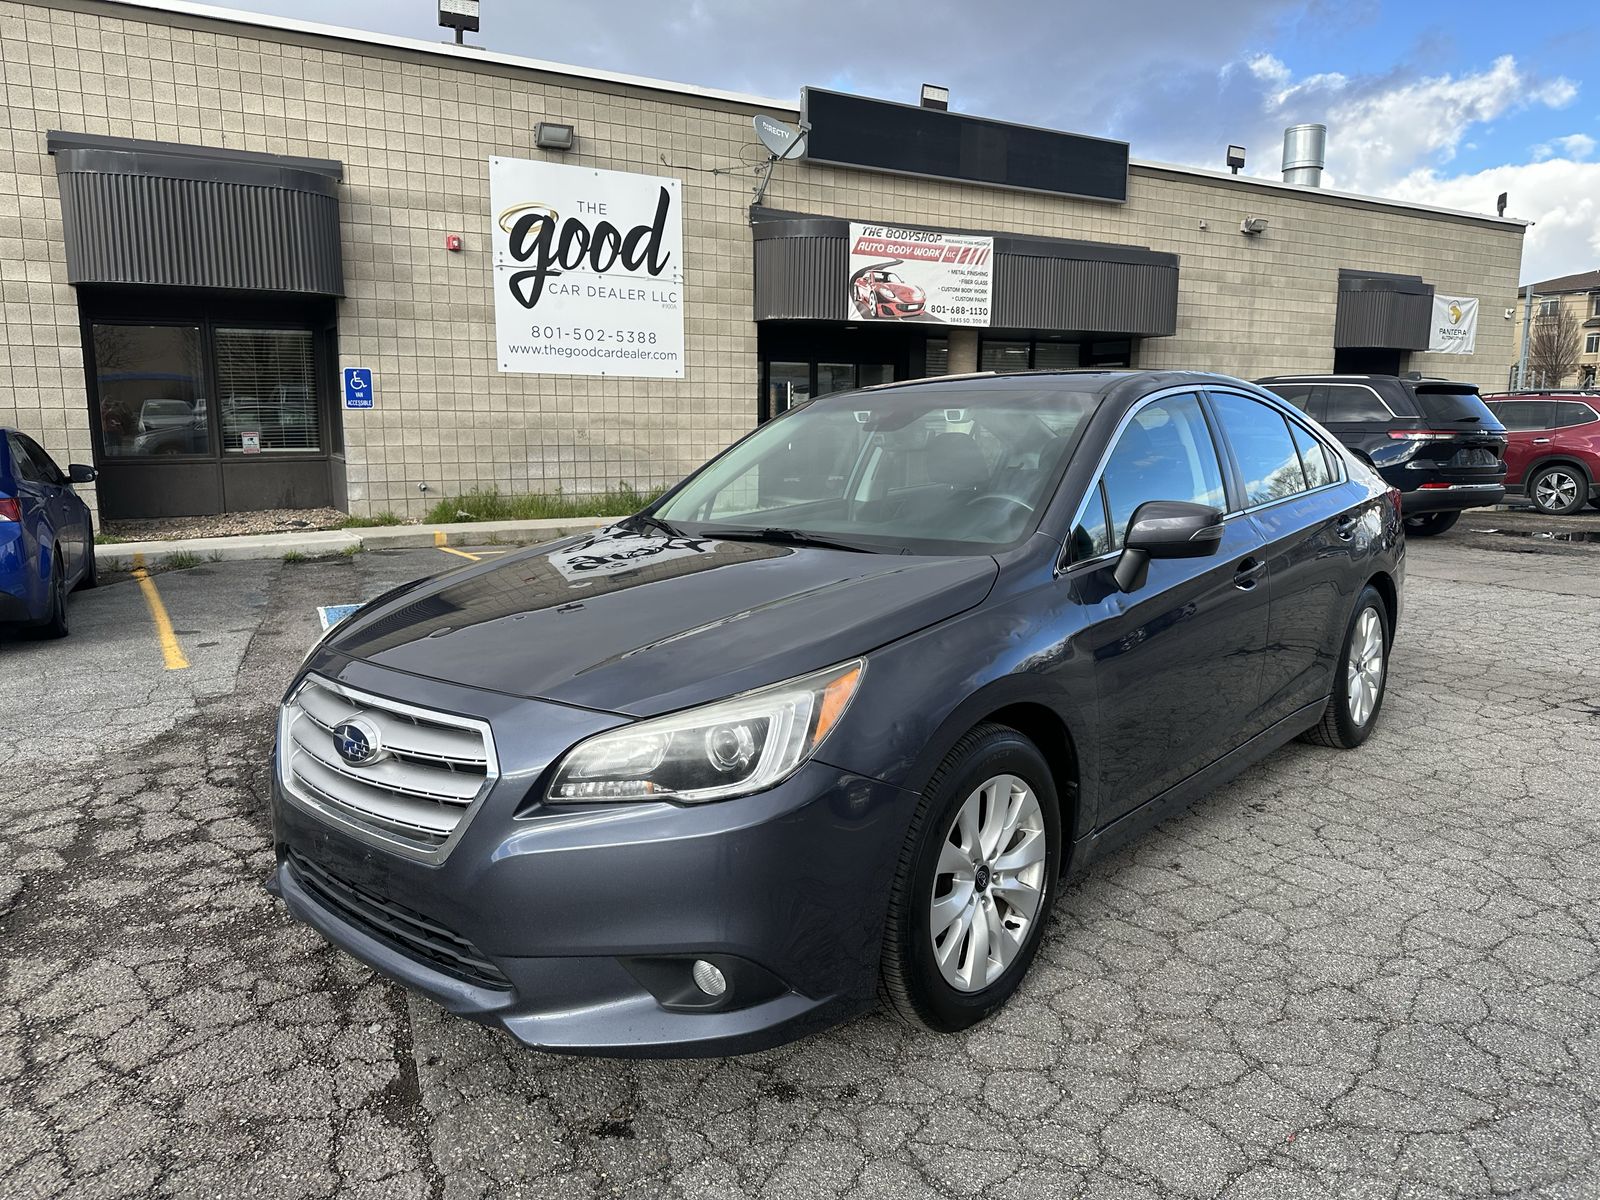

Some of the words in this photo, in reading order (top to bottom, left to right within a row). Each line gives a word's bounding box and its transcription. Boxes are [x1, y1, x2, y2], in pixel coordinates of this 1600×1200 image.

[576, 201, 608, 215] THE
[862, 226, 883, 238] THE
[886, 228, 943, 244] BODYSHOP
[508, 185, 671, 309] good
[857, 241, 885, 252] AUTO
[886, 244, 913, 254] BODY
[914, 247, 942, 258] WORK
[548, 283, 580, 296] CAR
[587, 286, 646, 301] DEALER
[652, 291, 677, 303] LLC
[931, 305, 988, 316] 801-688-1130
[531, 325, 657, 345] 801-502-5388
[1439, 328, 1467, 336] PANTERA
[508, 345, 678, 361] www.thegoodcardealer.com
